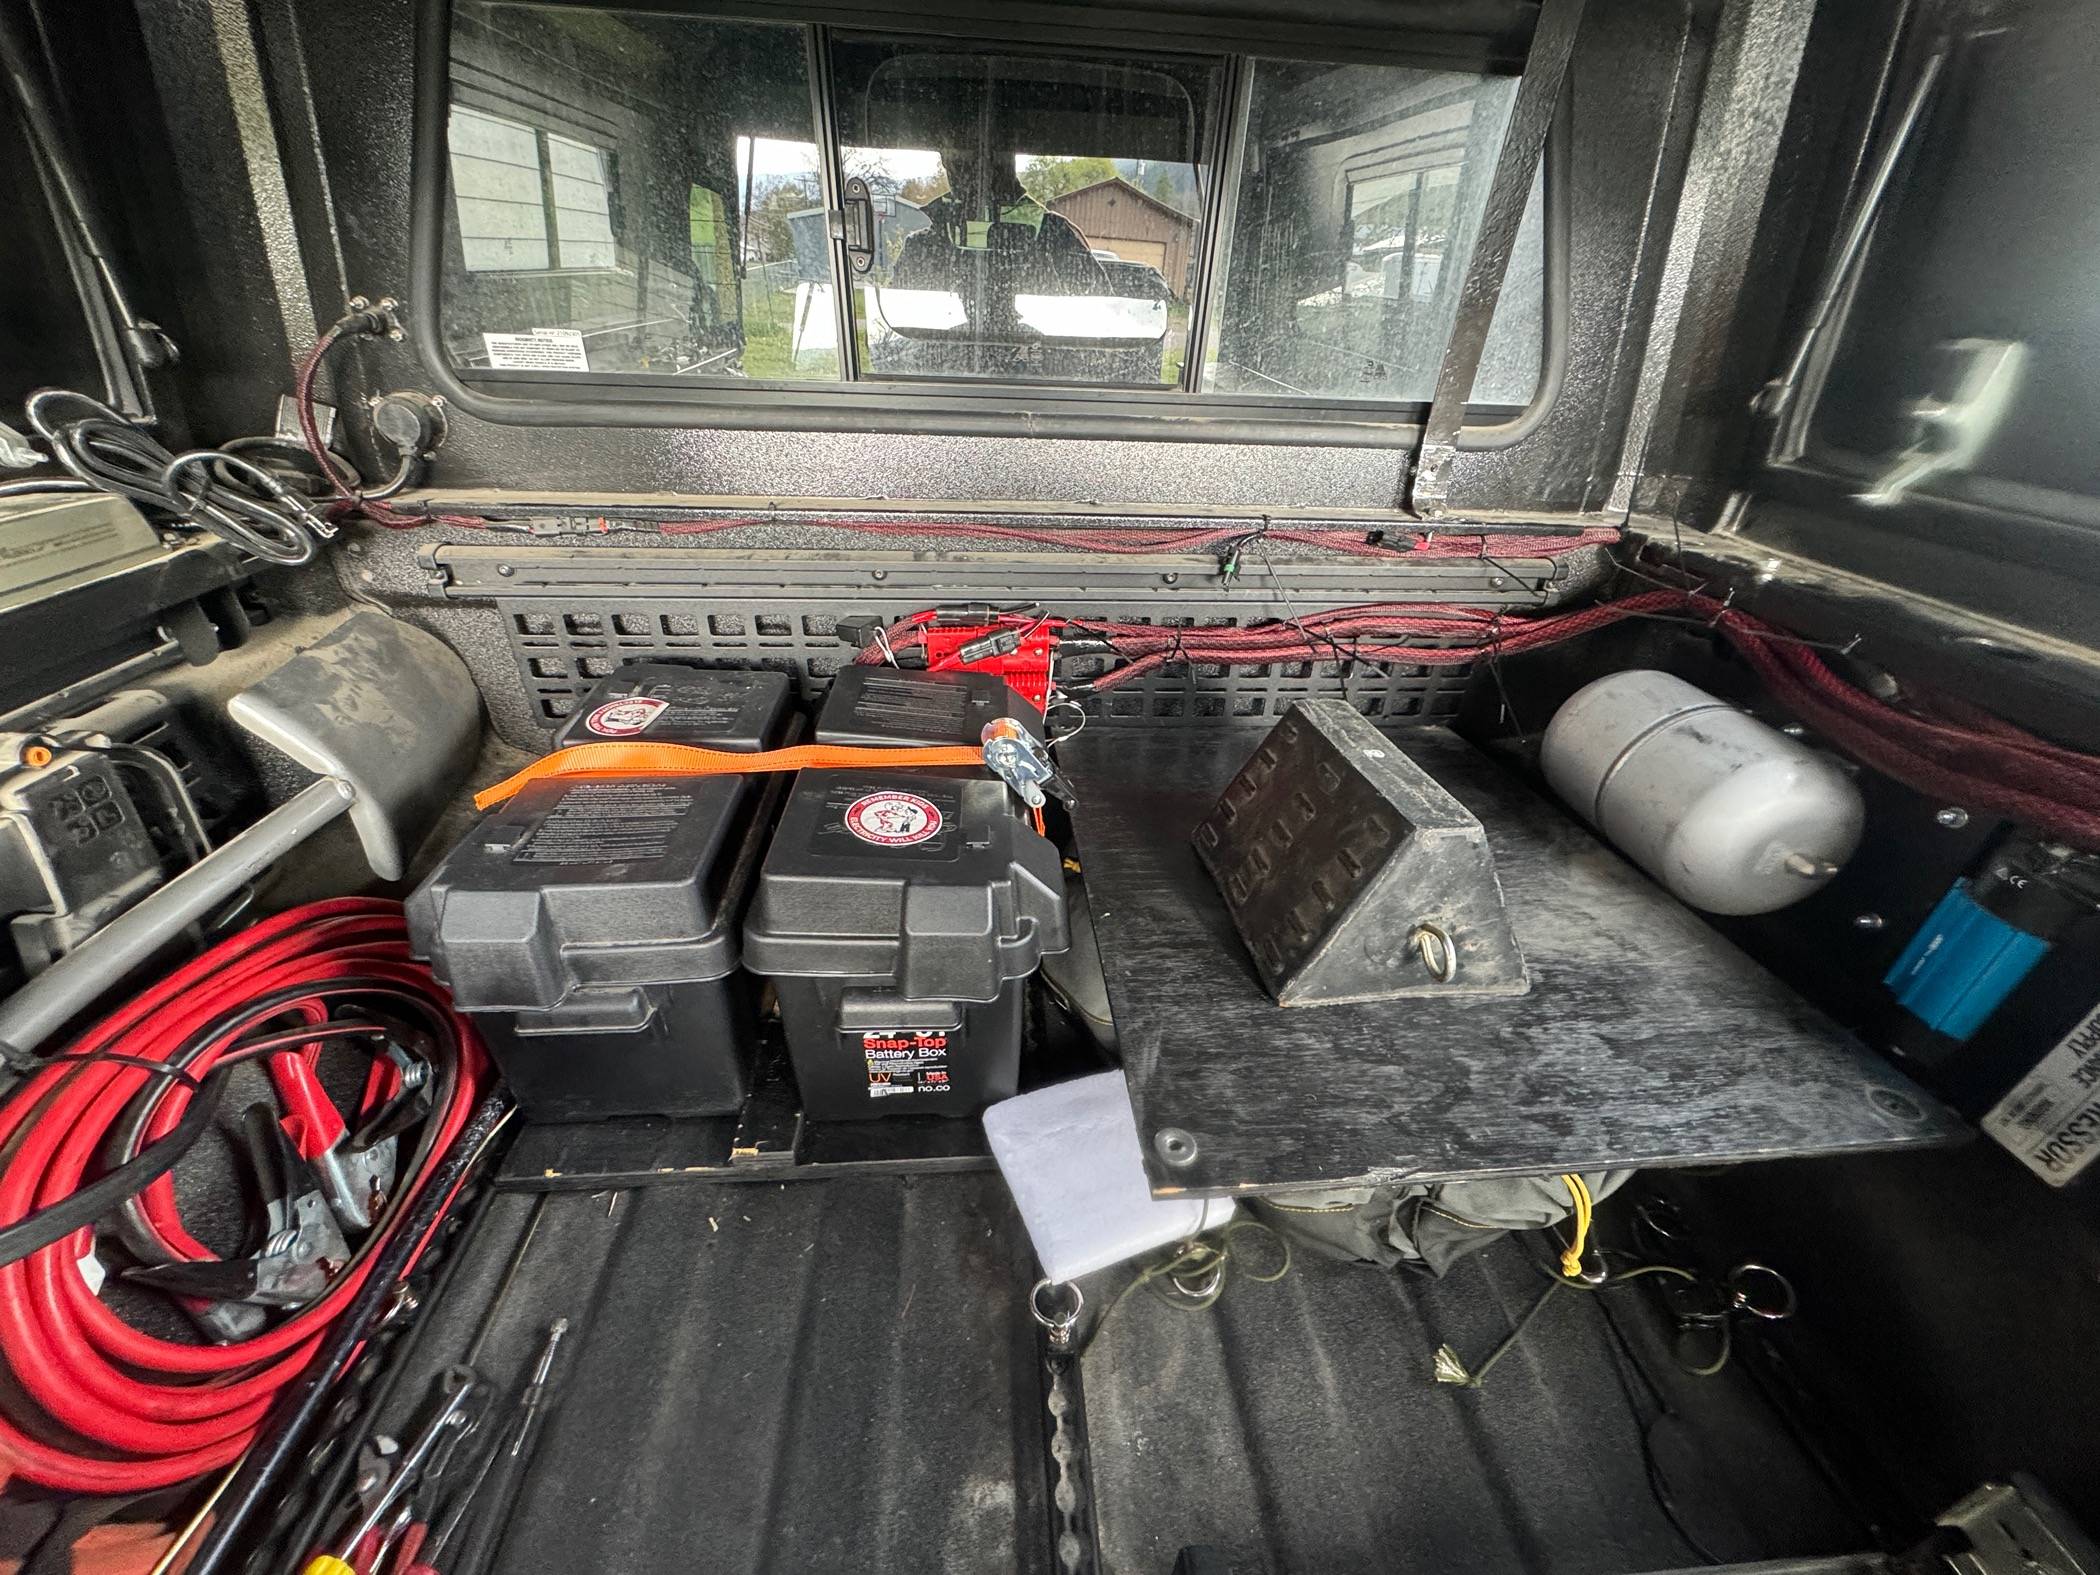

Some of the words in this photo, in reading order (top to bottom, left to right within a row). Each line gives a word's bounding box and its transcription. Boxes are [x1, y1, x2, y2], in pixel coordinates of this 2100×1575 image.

[861, 794, 910, 806] REMEMBER
[850, 816, 888, 842] ELECTRICITY
[864, 1037, 947, 1050] Snap-Top
[865, 1049, 915, 1060] Battery
[919, 1047, 947, 1057] Box
[869, 1072, 892, 1083] UV
